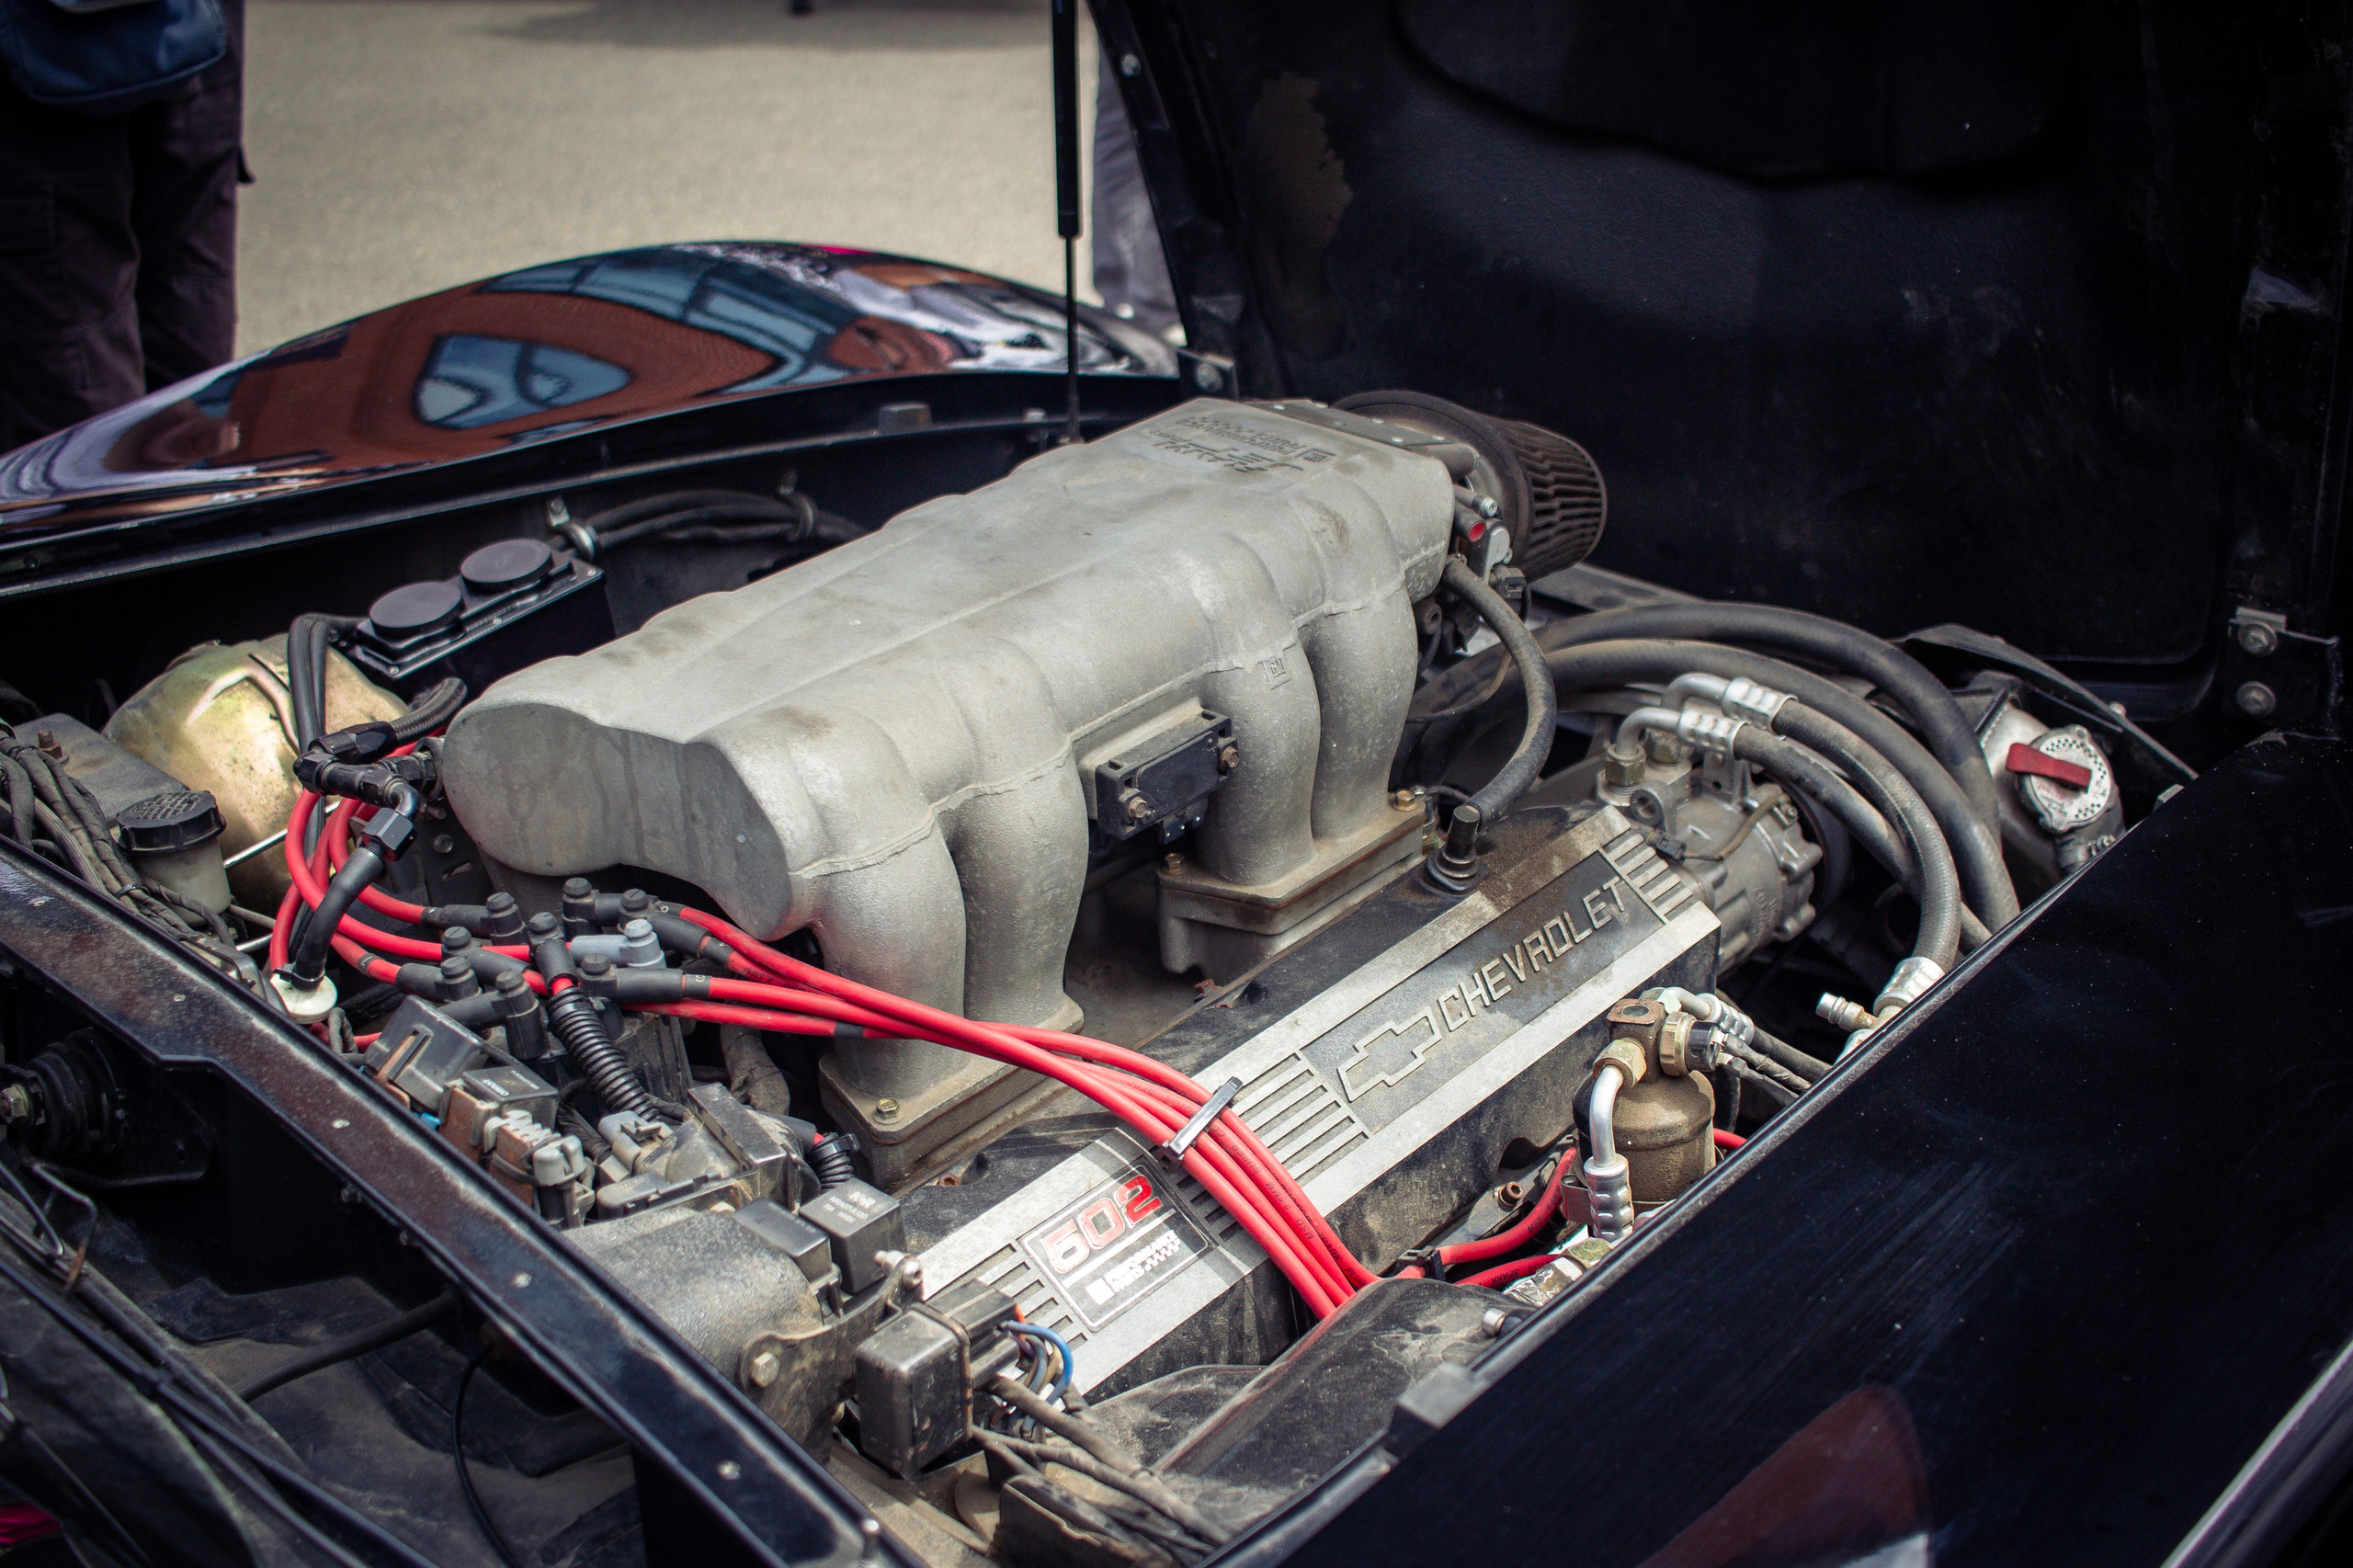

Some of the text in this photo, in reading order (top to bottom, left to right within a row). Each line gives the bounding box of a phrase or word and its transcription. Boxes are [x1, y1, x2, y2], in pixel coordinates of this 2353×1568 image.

[1438, 876, 1625, 1032] CHEVROLET
[1232, 1144, 1262, 1174] SUPER
[1266, 1181, 1292, 1210] 8.5MM
[1040, 1175, 1165, 1275] 502
[1296, 1218, 1315, 1240] MSD
[1527, 1216, 1544, 1235] MSD
[1490, 1269, 1520, 1285] SPARK
